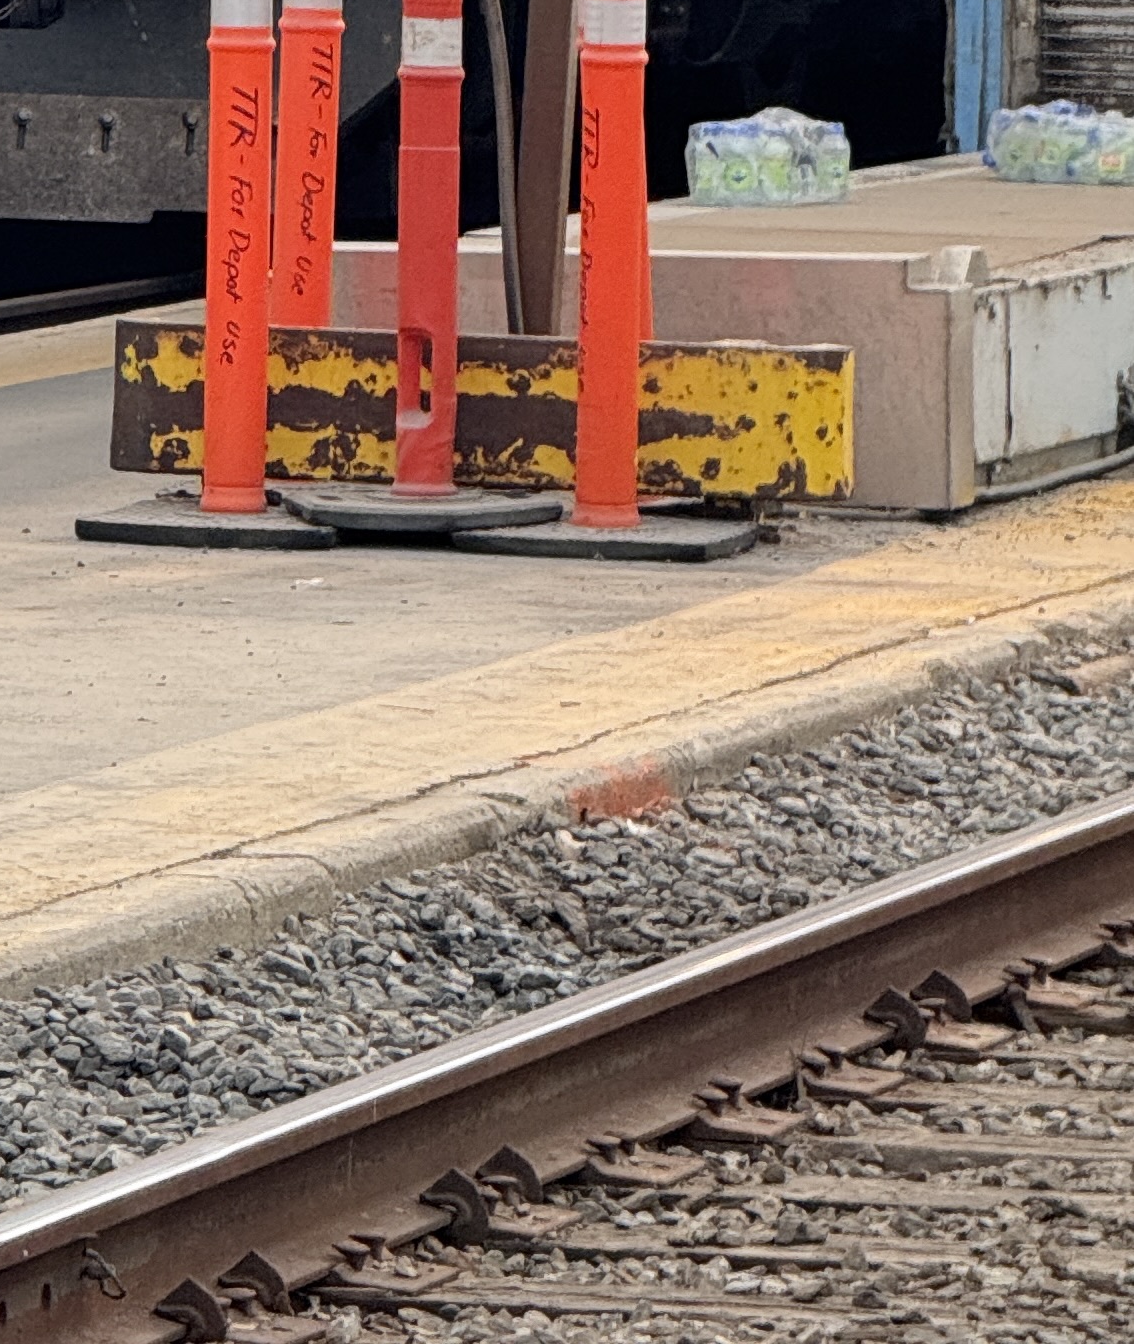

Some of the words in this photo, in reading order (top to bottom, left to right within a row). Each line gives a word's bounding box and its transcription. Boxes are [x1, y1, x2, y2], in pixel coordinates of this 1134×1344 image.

[309, 42, 334, 100] TTR
[227, 86, 259, 148] TTR
[308, 126, 328, 159] For
[228, 175, 254, 219] For
[298, 171, 325, 244] Depot
[221, 228, 252, 305] Depot
